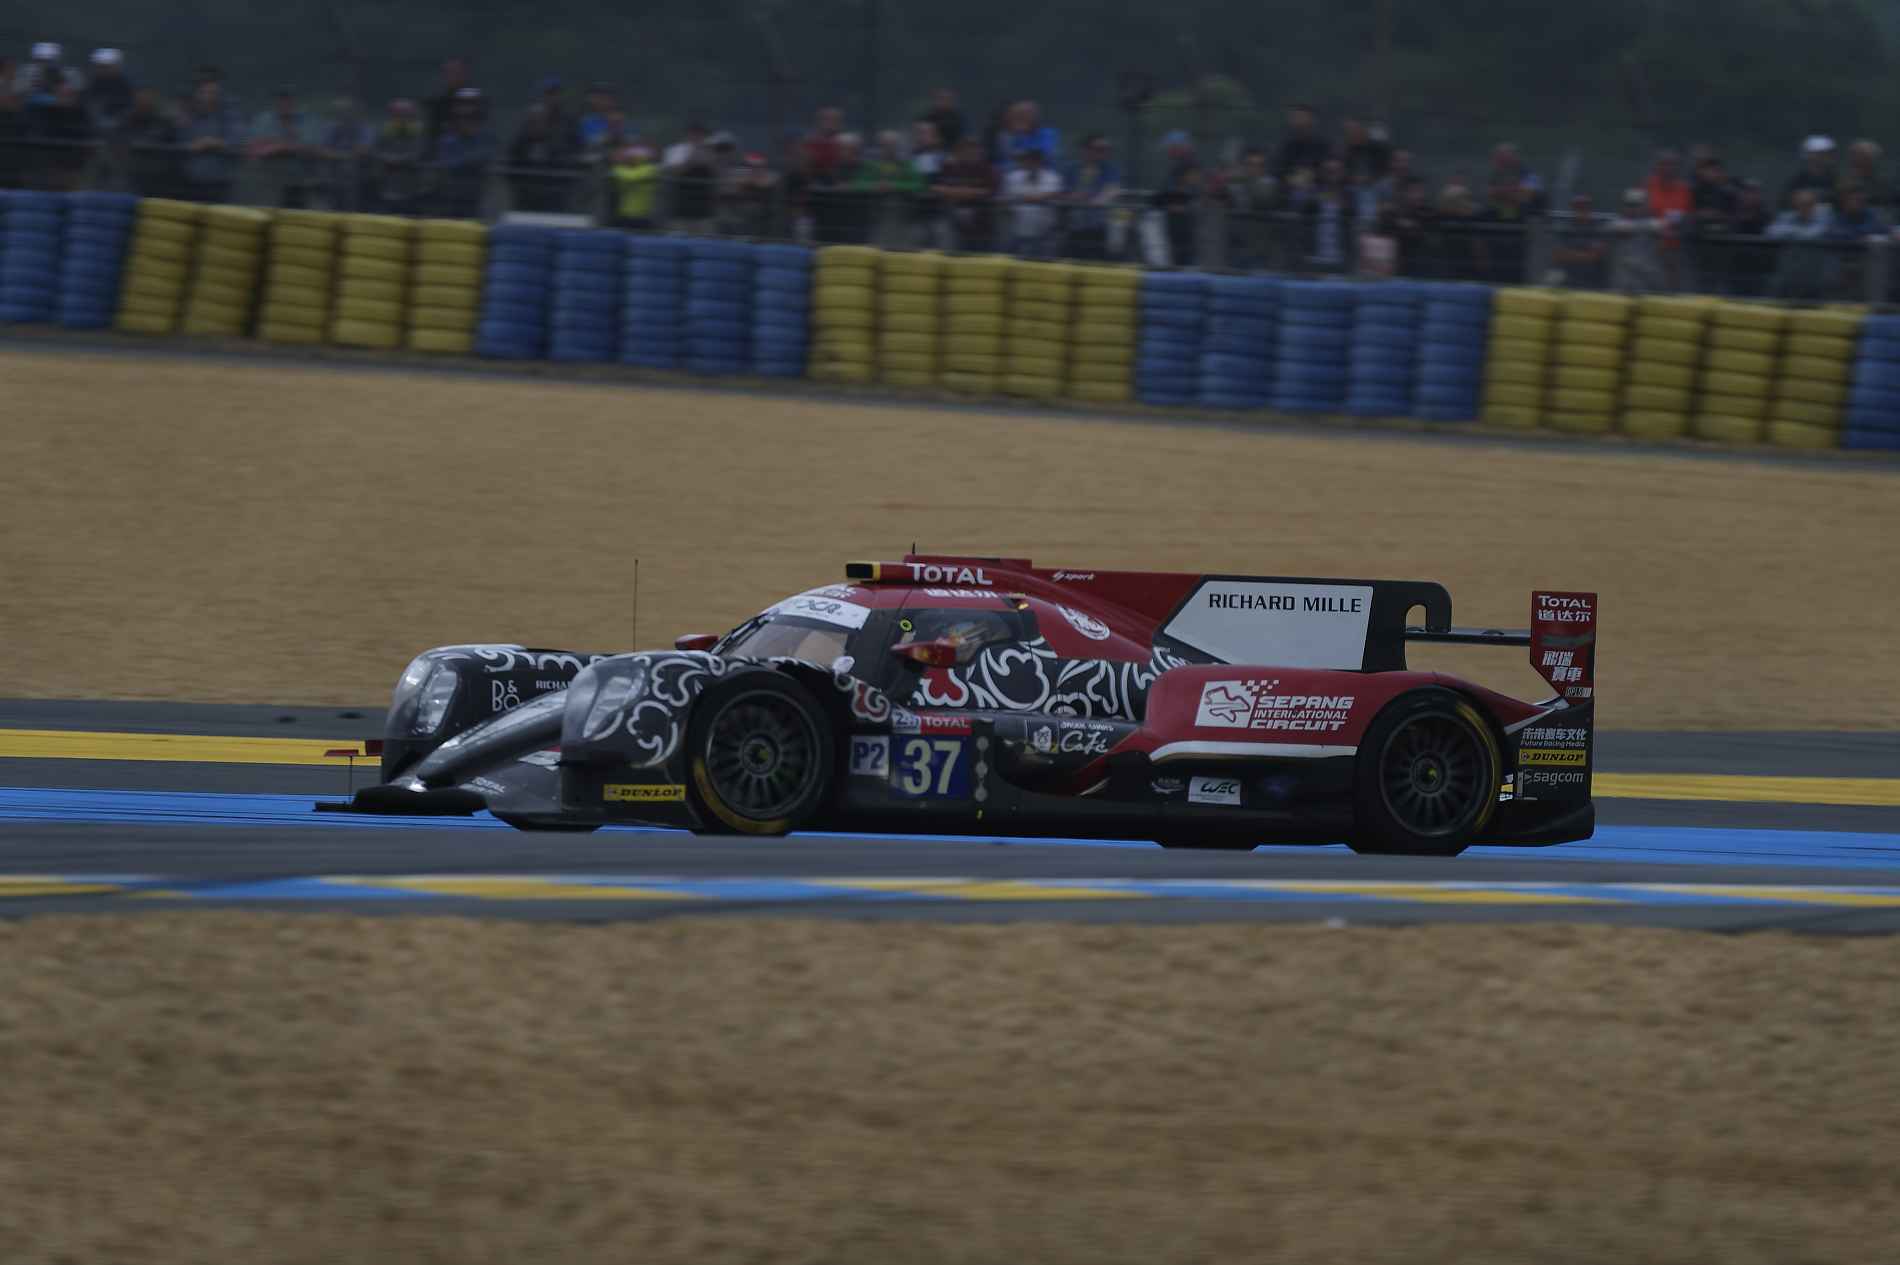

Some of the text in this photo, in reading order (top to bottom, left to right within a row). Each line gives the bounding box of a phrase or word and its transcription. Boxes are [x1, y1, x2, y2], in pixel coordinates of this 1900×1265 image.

[905, 562, 992, 585] TOTAL
[1209, 593, 1362, 613] RICHARD MILLE
[1538, 595, 1592, 608] TOTAL
[536, 680, 570, 689] RICHA
[1256, 695, 1355, 709] SEPANG
[1254, 709, 1348, 720] INTERNATIONAL
[923, 716, 970, 729] TOTAL
[1251, 719, 1346, 731] CIRCUIT
[853, 742, 886, 770] P2
[1531, 752, 1584, 762] DUNLOP
[903, 738, 961, 795] 37
[1533, 772, 1585, 786] sagcom
[620, 787, 683, 798] DUNLOP
